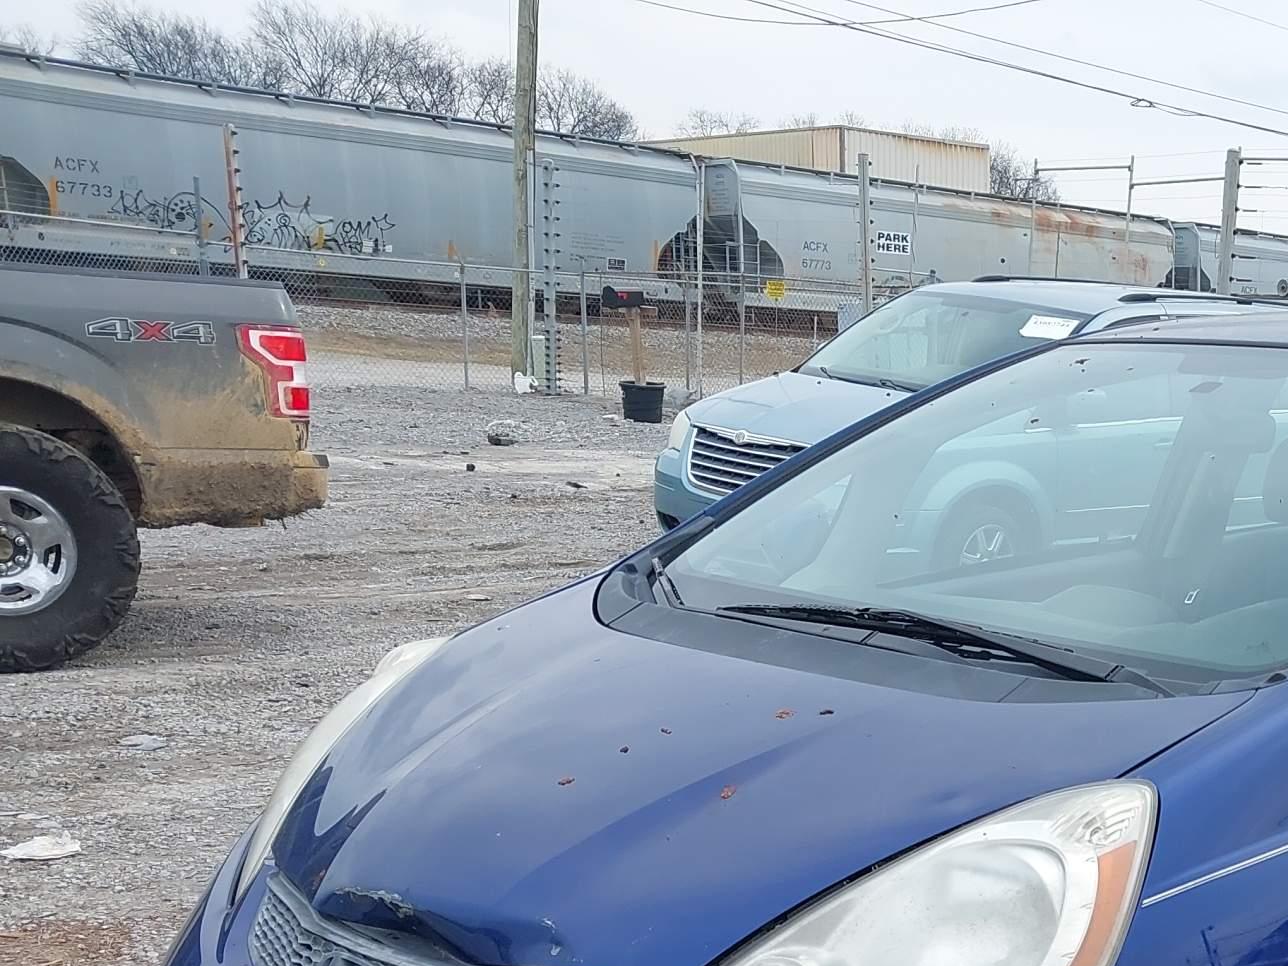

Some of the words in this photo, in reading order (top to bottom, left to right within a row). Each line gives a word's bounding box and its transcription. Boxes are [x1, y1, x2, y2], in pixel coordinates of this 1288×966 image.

[54, 156, 100, 173] ACFX
[55, 180, 112, 198] 67733
[877, 231, 909, 243] PARK
[803, 241, 829, 253] ACFX
[877, 242, 909, 254] HERE
[801, 258, 832, 271] 67773
